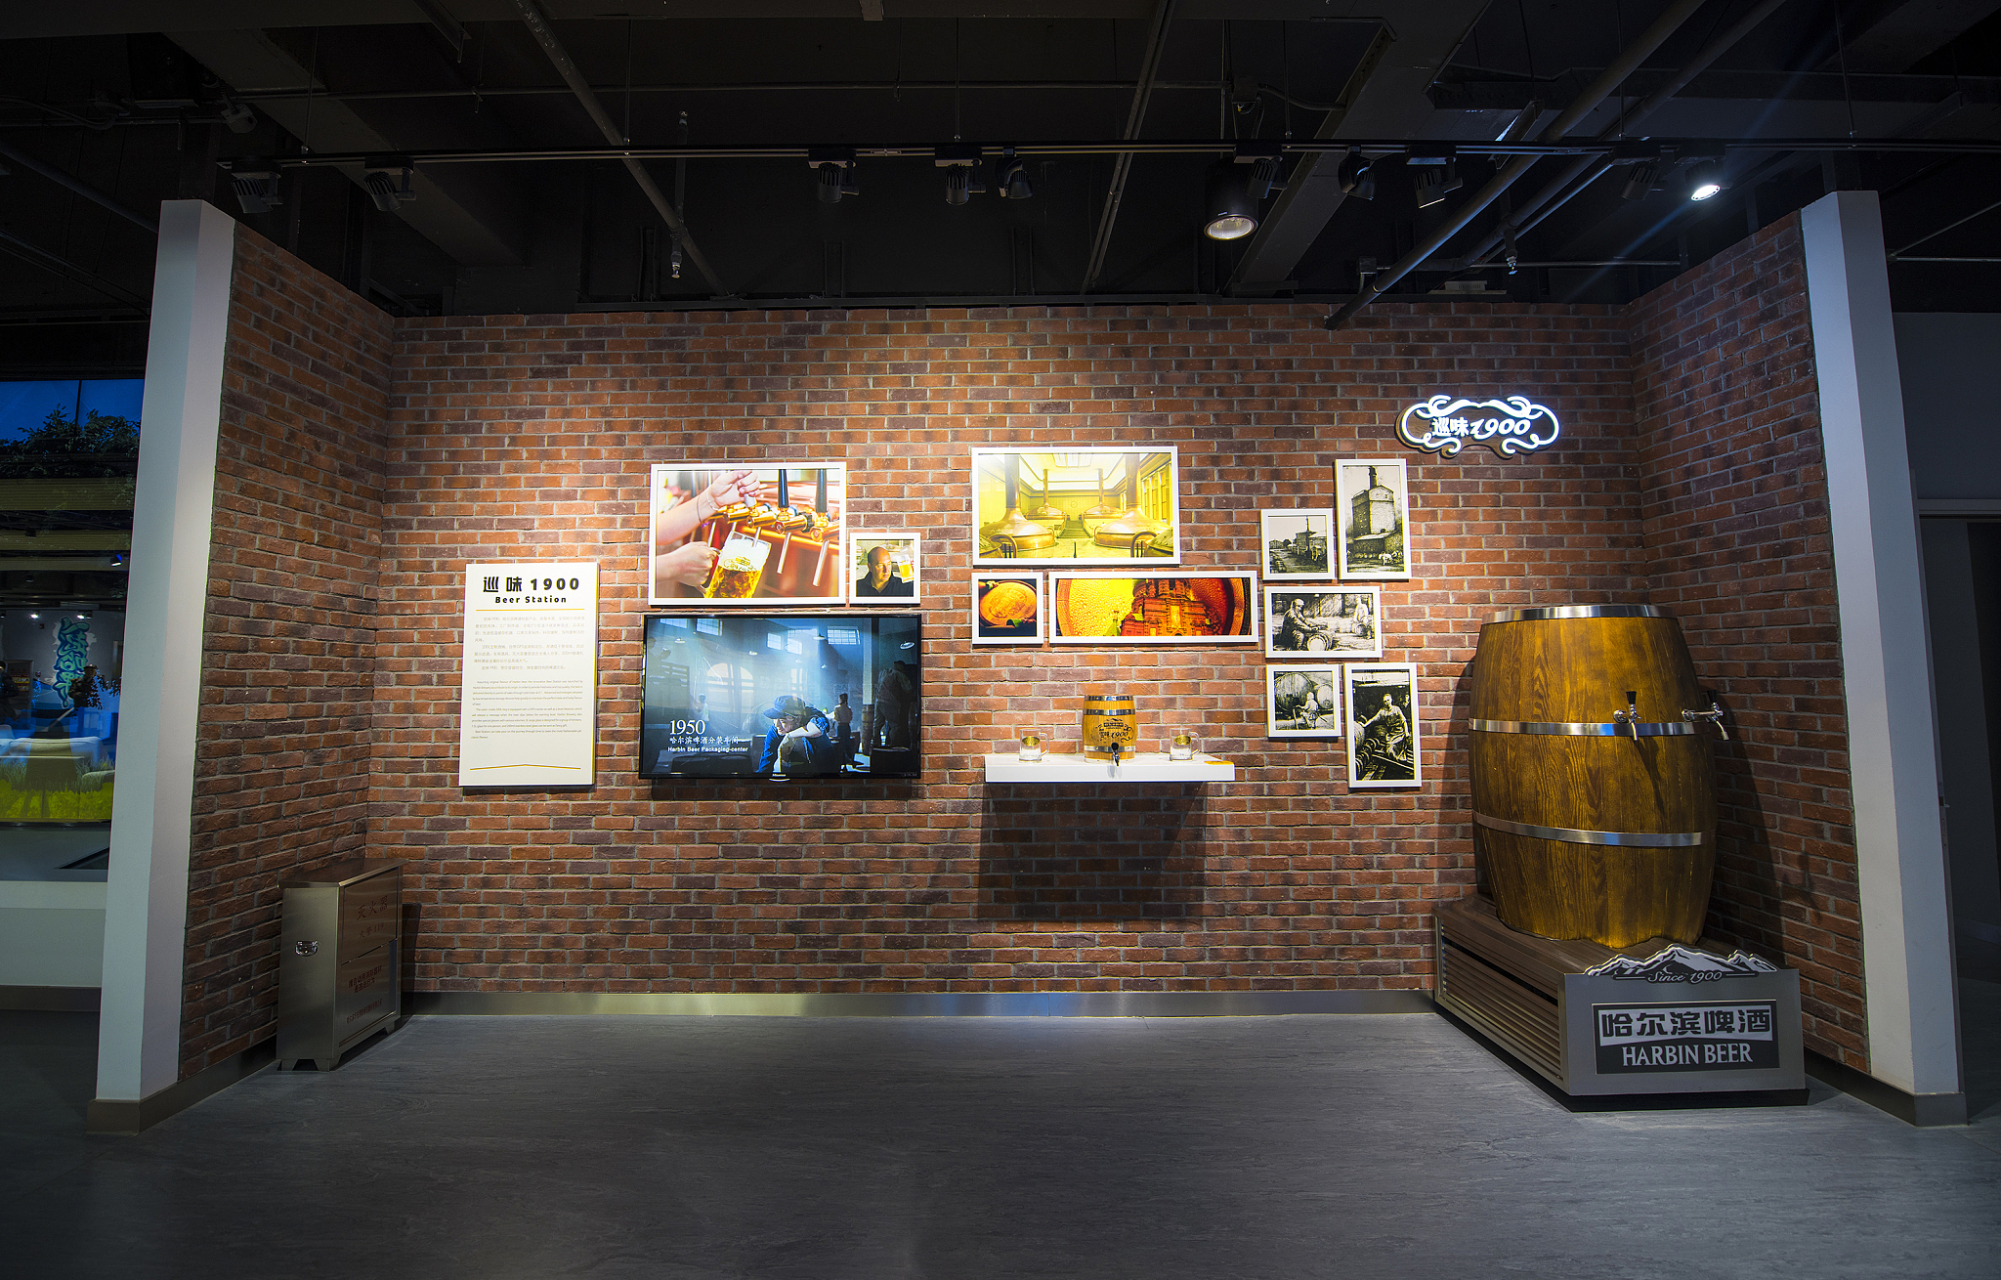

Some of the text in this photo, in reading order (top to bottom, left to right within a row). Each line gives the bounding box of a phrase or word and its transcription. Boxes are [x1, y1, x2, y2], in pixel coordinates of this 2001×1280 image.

[495, 595, 567, 604] Beer Station
[669, 719, 706, 735] 1950
[1648, 970, 1723, 984] Since 1900
[1601, 1009, 1771, 1037] 哈尔滨啤酒
[1622, 1043, 1754, 1066] HARBIN BEER
